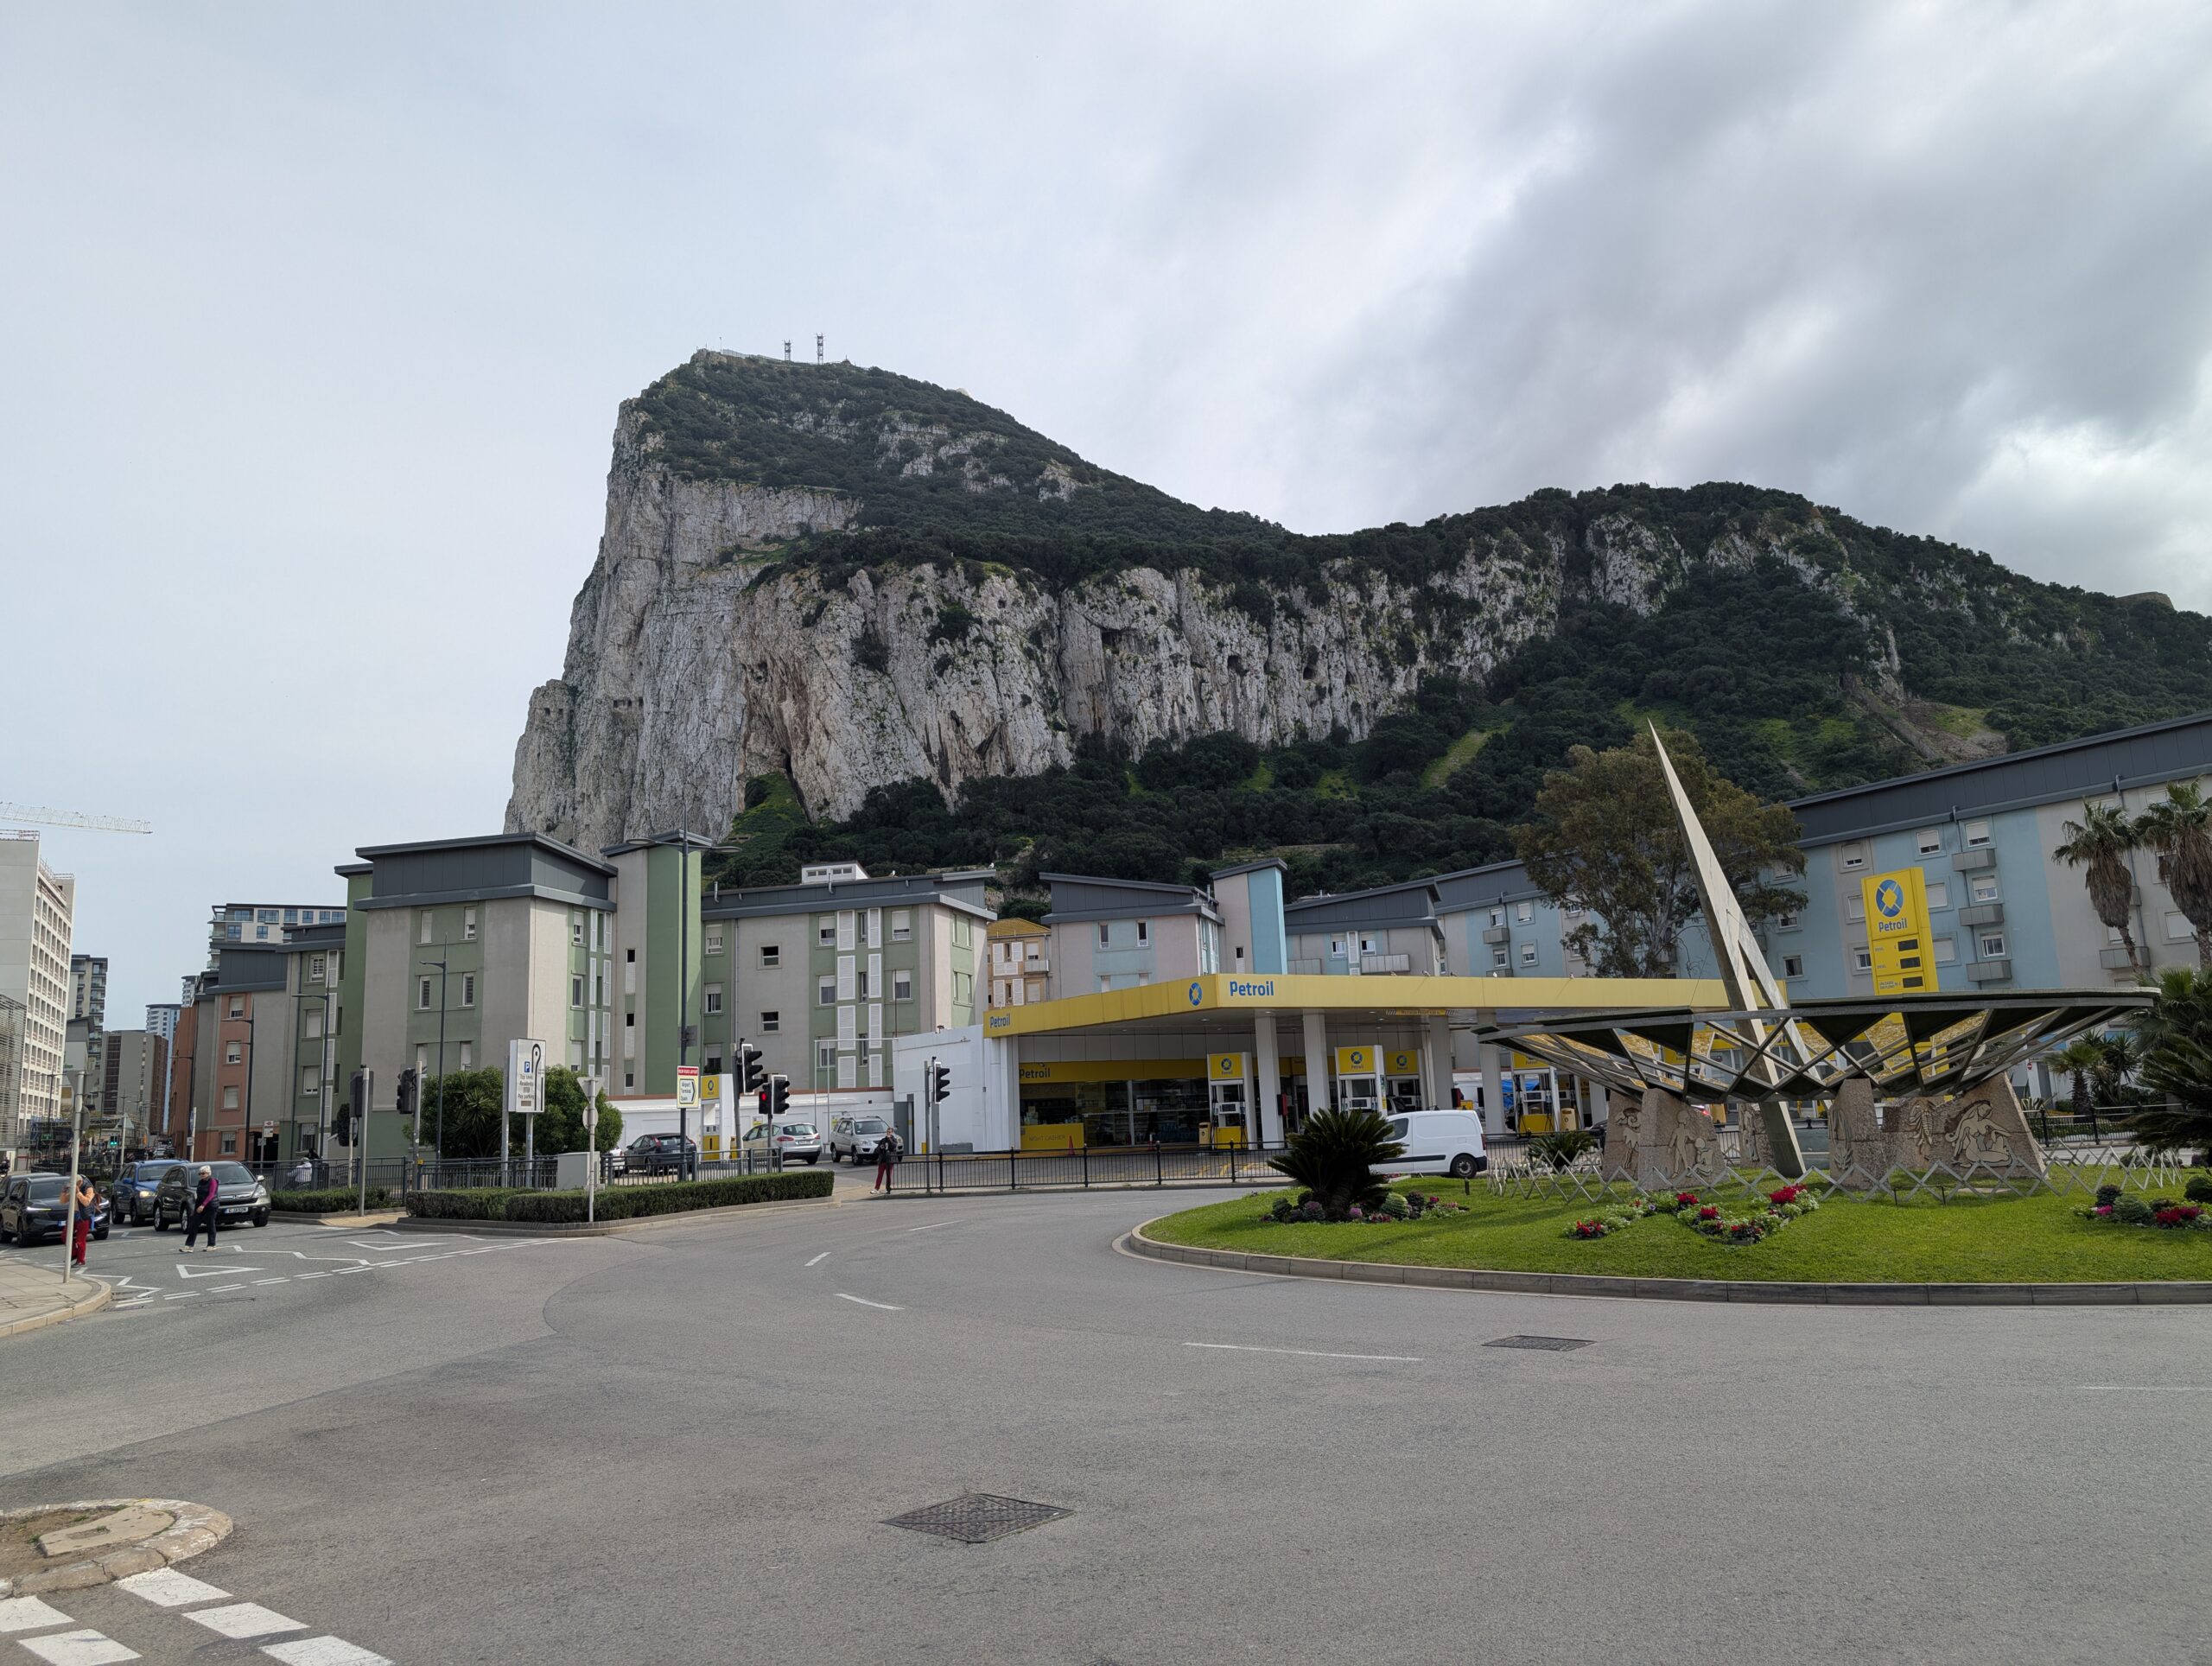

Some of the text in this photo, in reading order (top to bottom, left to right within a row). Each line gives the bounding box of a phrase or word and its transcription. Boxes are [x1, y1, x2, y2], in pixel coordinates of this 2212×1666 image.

[1878, 918, 1907, 932] Petroil
[1230, 981, 1274, 996] Petroil
[989, 1013, 1010, 1028] Petroil
[1020, 1068, 1051, 1079] Petroil
